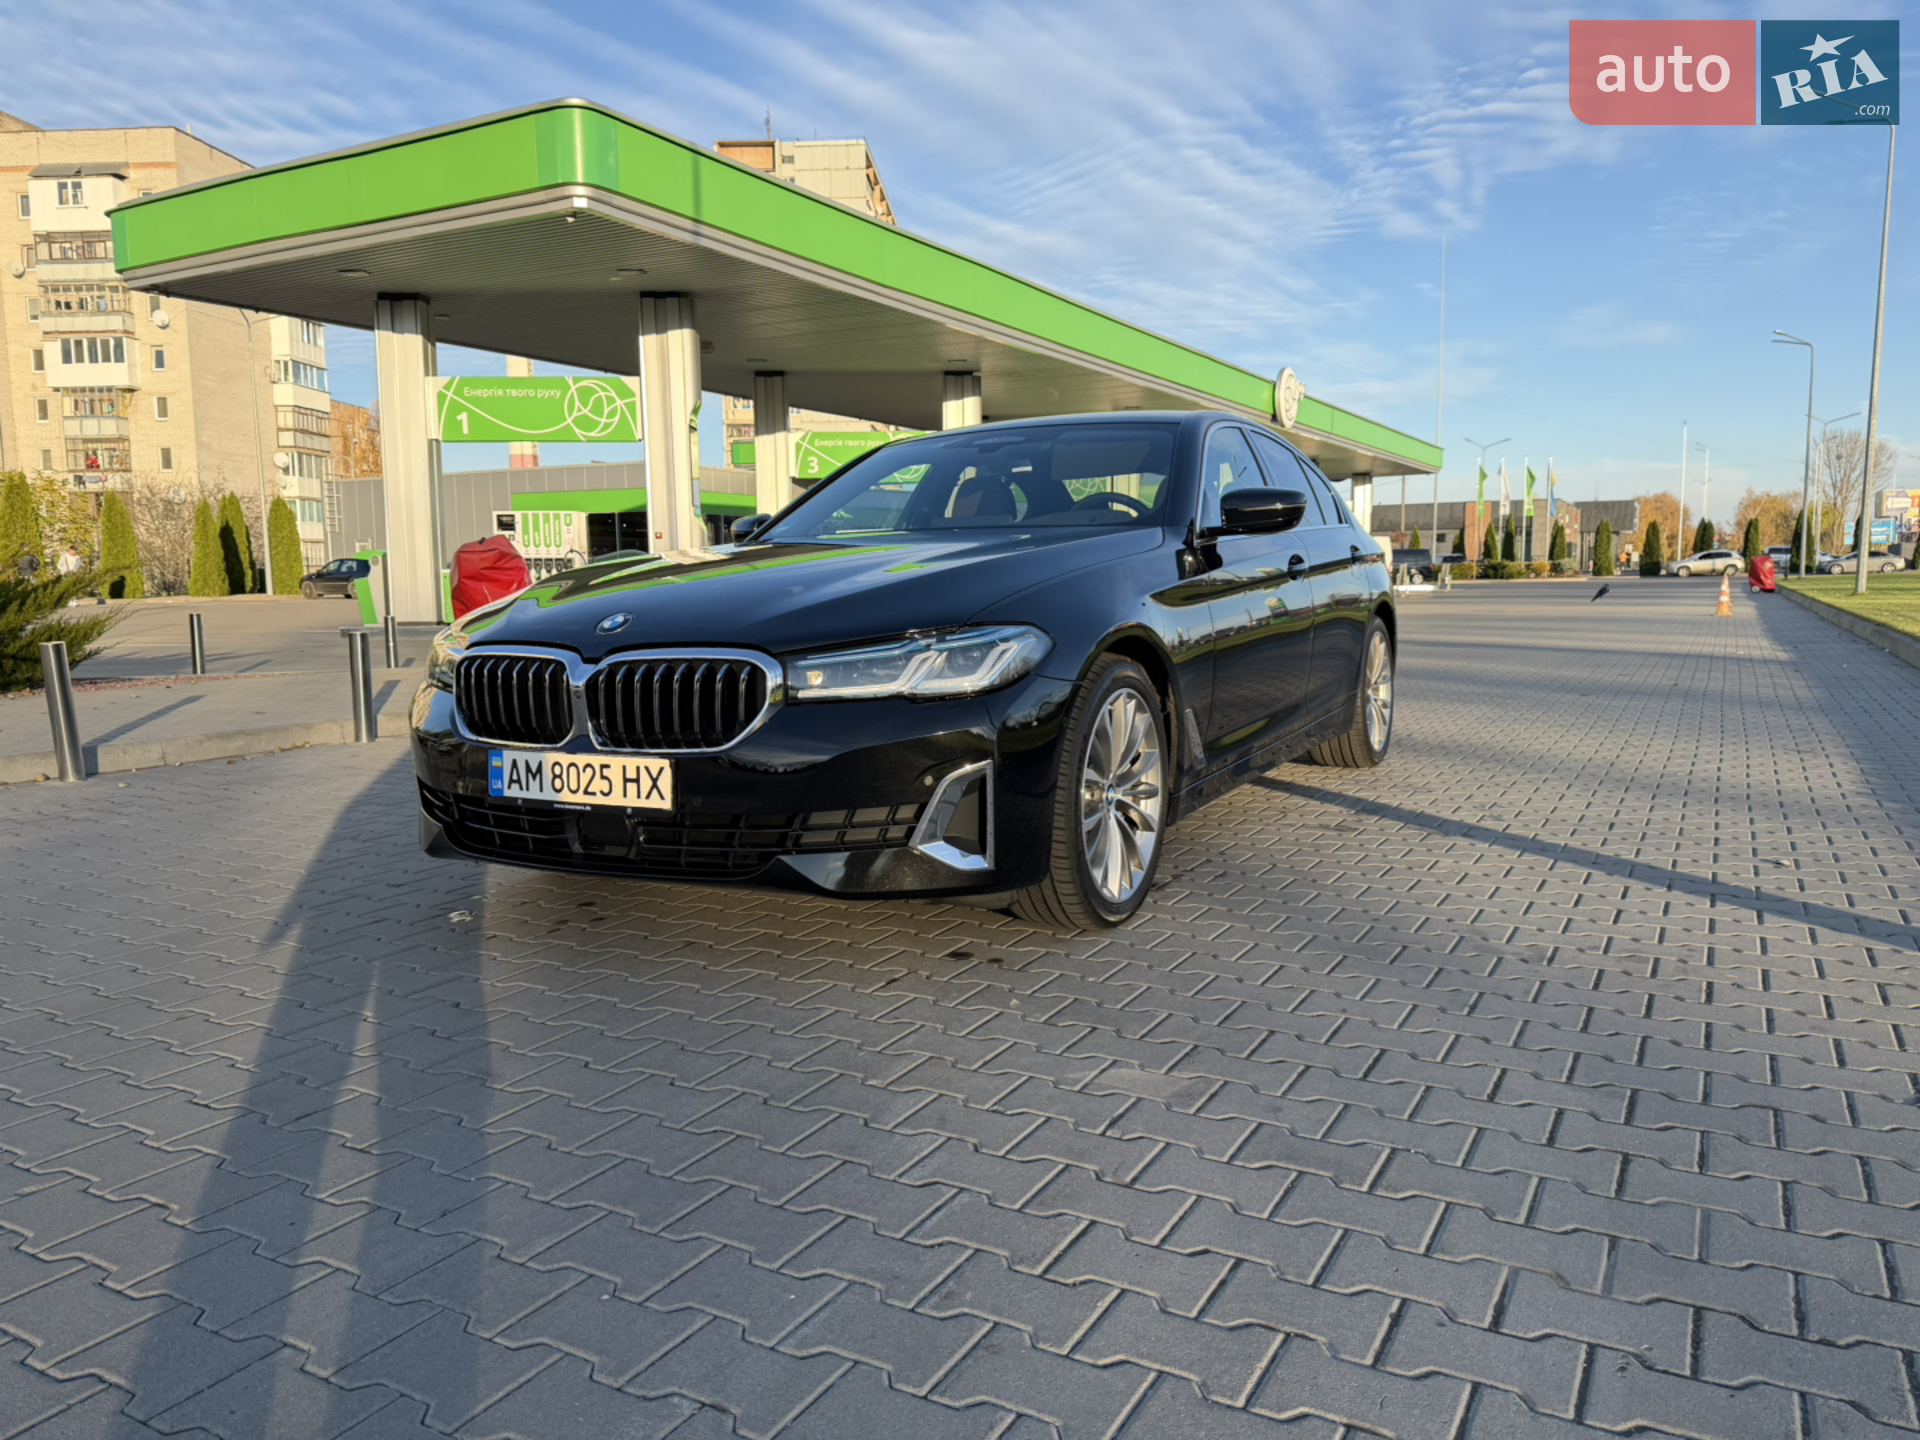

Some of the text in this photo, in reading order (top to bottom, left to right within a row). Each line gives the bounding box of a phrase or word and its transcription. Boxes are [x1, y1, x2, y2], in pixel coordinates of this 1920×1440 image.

[464, 387, 561, 399] Енергія твого руху
[456, 411, 470, 435] 1
[815, 439, 843, 447] Енергія
[807, 456, 820, 474] 3
[492, 779, 502, 790] UA
[507, 758, 666, 801] AM 8025 HX
